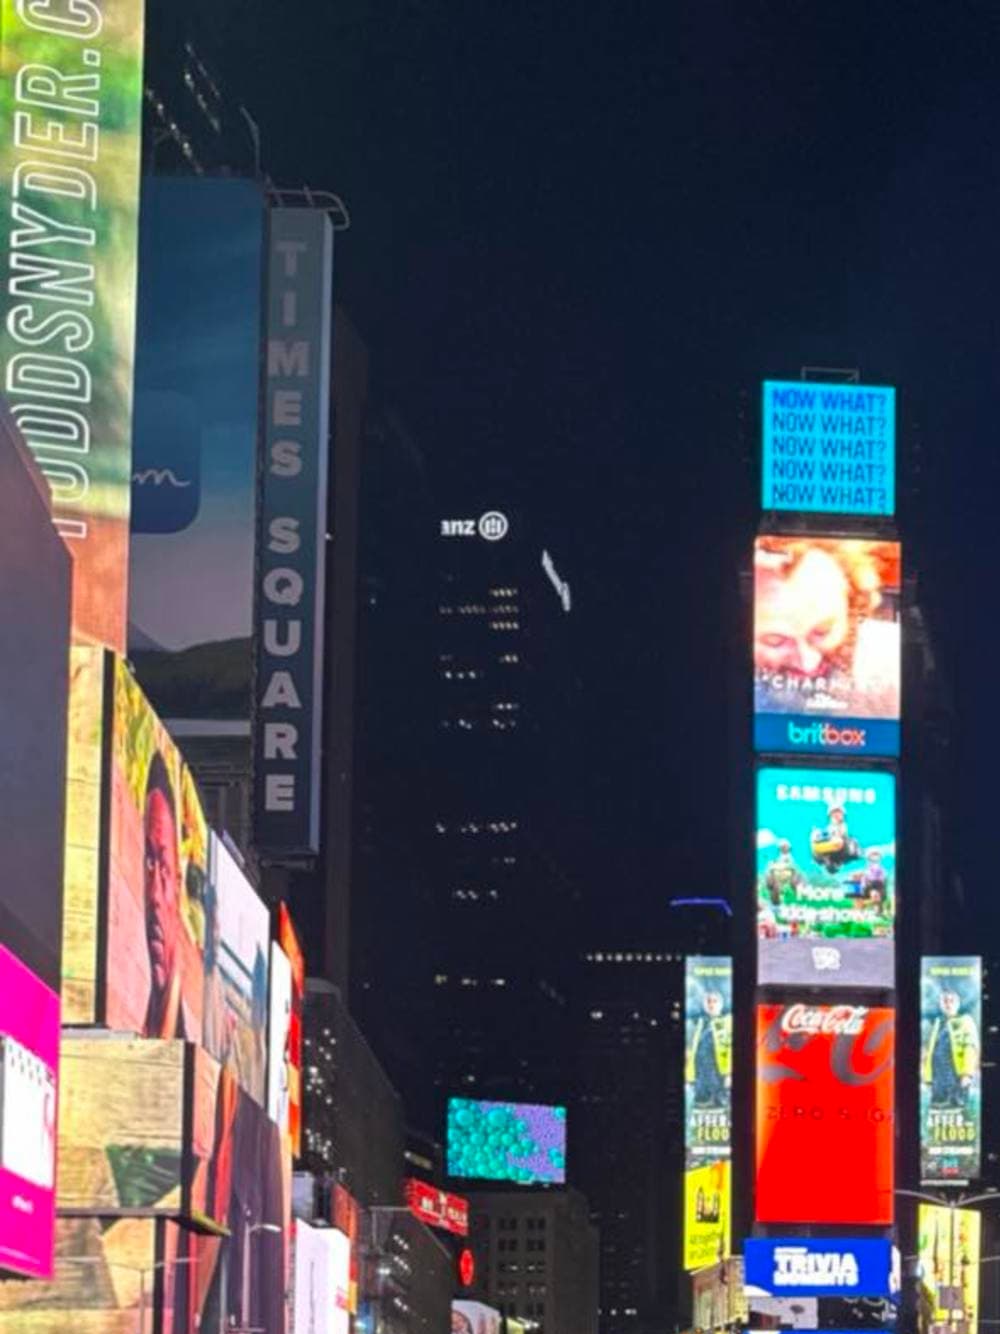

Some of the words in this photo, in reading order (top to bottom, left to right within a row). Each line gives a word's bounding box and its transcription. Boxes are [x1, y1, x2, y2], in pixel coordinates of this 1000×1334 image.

[266, 240, 312, 477] TIMES
[772, 388, 816, 409] NOW
[821, 391, 885, 413] WHAT?
[772, 412, 816, 433] NOW
[821, 414, 886, 437] WHAT?
[772, 436, 816, 457] NOW
[821, 438, 886, 460] WHAT?
[772, 459, 816, 480] NOW
[821, 461, 886, 484] WHAT?
[772, 483, 816, 505] NOW
[821, 485, 886, 508] WHAT?
[262, 516, 304, 812] SQUARE
[788, 721, 866, 746] britbox
[776, 783, 876, 805] SAMSUNG
[782, 1004, 870, 1034] Coca-Cola
[775, 1252, 858, 1273] TRIVIA
